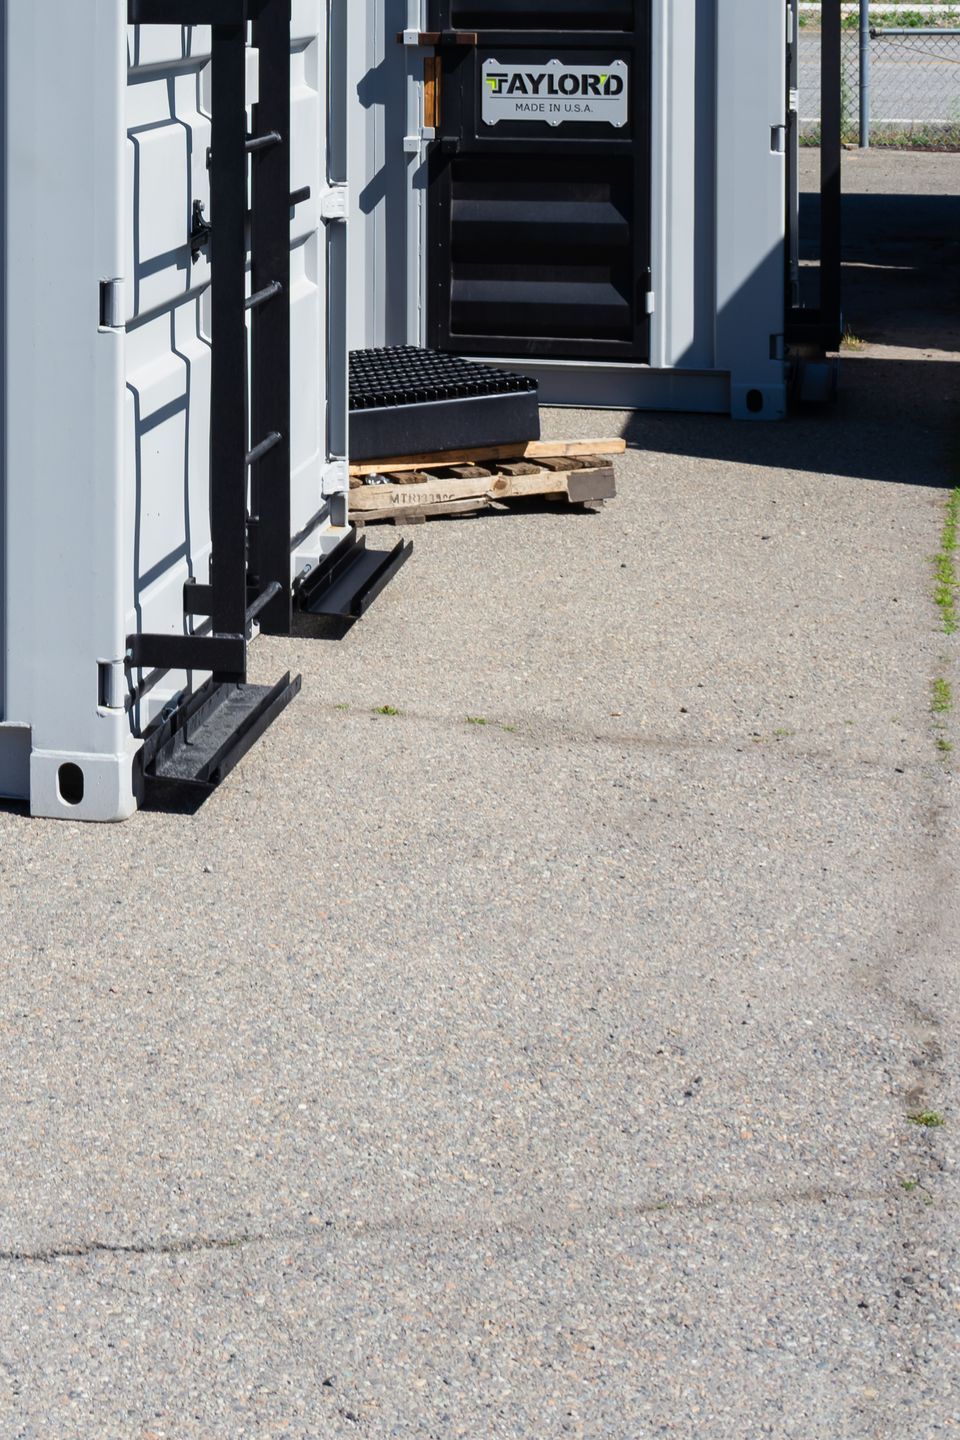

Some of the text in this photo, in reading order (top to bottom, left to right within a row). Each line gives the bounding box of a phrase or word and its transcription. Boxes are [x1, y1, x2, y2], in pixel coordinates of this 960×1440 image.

[515, 103, 594, 113] MADE IN U.S.A.
